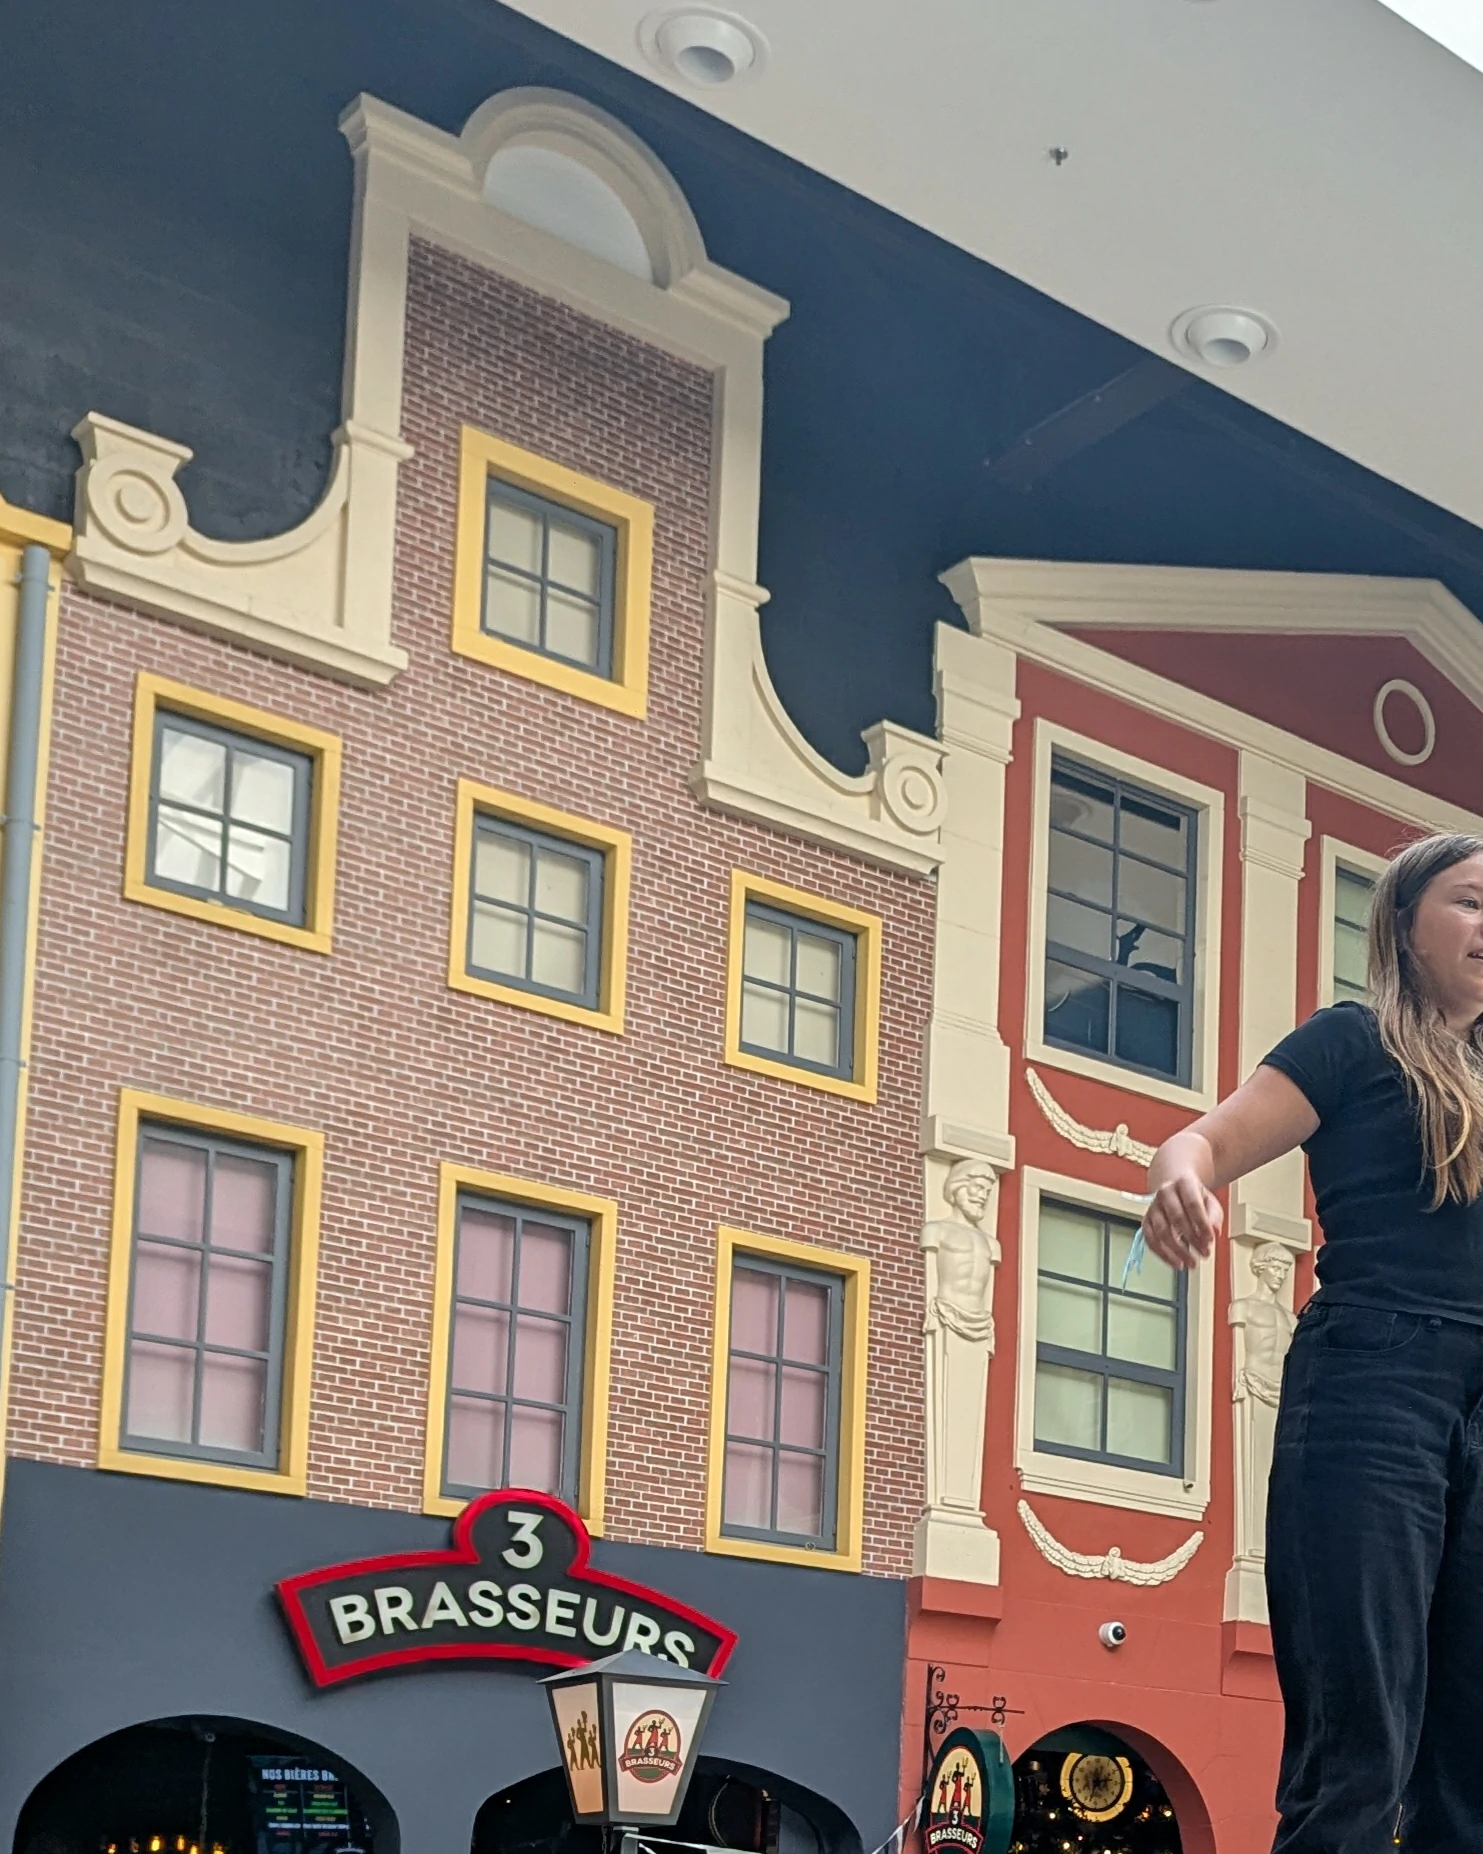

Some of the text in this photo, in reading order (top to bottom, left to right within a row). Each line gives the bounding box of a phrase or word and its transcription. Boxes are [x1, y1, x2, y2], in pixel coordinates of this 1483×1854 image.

[502, 1511, 543, 1569] 3
[329, 1581, 695, 1668] BRASSEURS
[625, 1757, 676, 1771] BRASSEURS
[951, 1810, 959, 1825] 3
[930, 1827, 978, 1850] BRASSEURS
